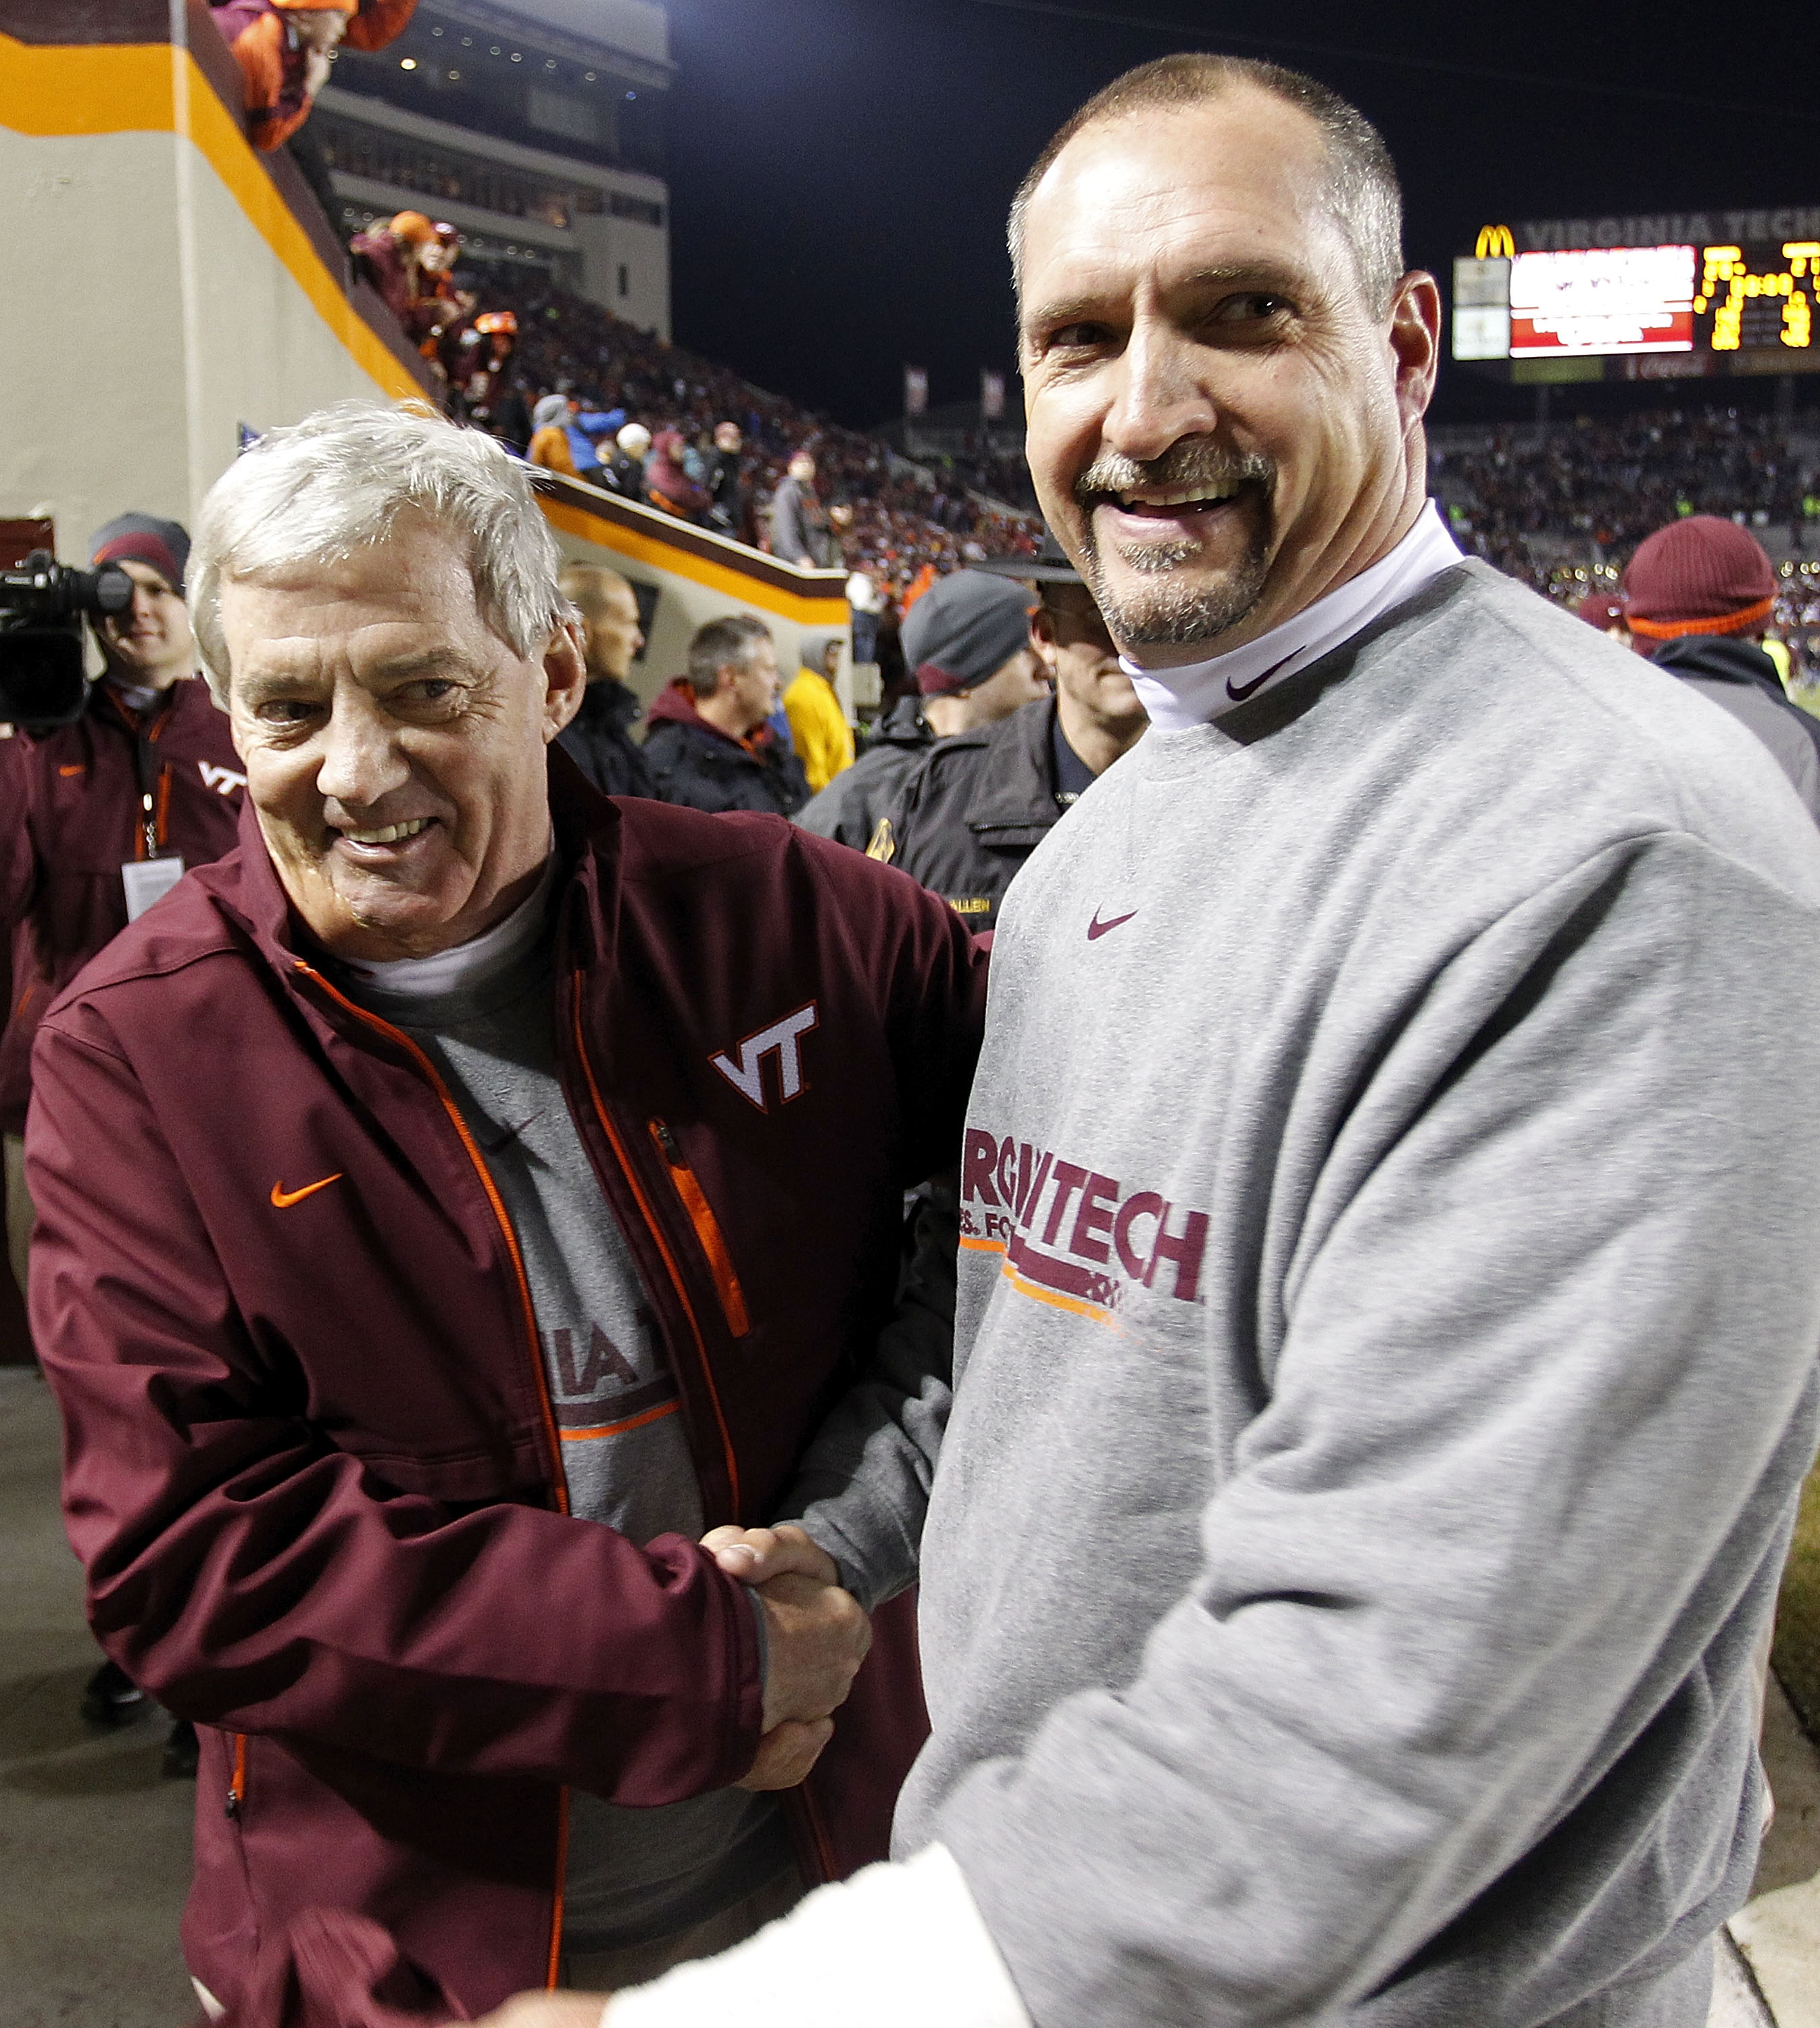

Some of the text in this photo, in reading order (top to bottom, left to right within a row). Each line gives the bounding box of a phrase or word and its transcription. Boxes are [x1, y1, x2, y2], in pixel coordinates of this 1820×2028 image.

[1523, 214, 1714, 251] VIRGINIA
[197, 760, 247, 795] VT
[708, 1000, 818, 1114] VT
[1043, 1160, 1210, 1301] TECH
